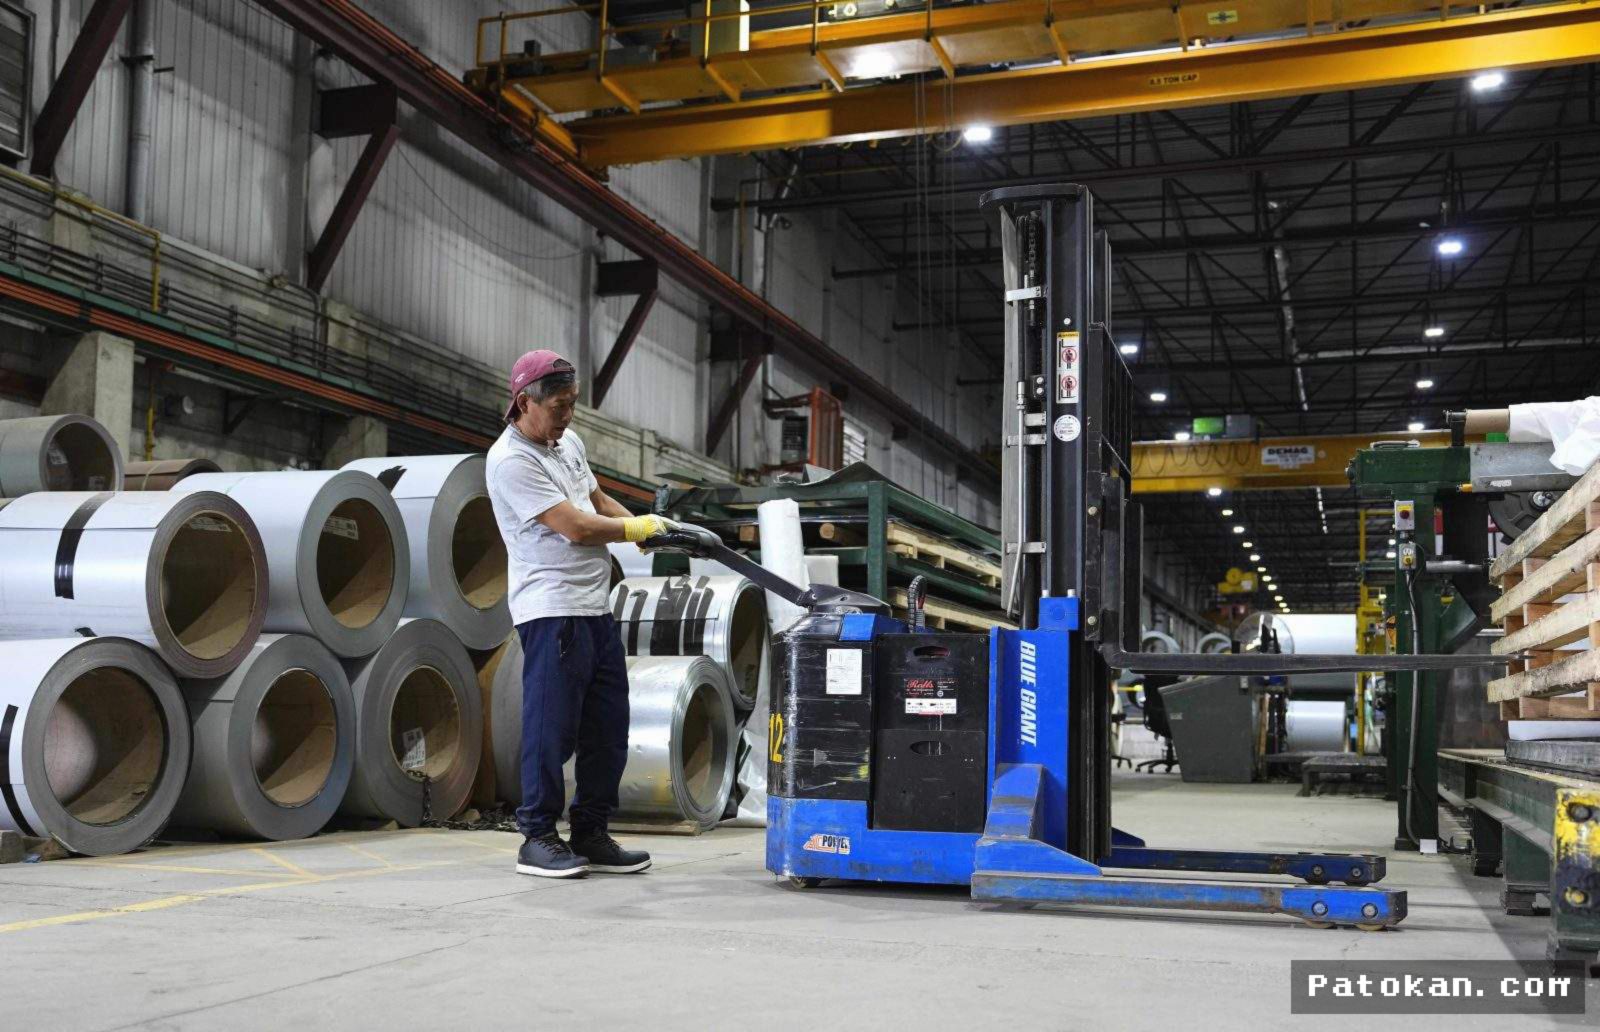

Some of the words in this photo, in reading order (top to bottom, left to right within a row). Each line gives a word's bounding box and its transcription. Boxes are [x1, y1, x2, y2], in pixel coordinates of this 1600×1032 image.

[1164, 76, 1179, 84] TON
[1268, 447, 1308, 455] DEMAG
[1021, 640, 1036, 687] BLUE
[770, 713, 783, 763] 12
[1021, 688, 1036, 747] GIANT
